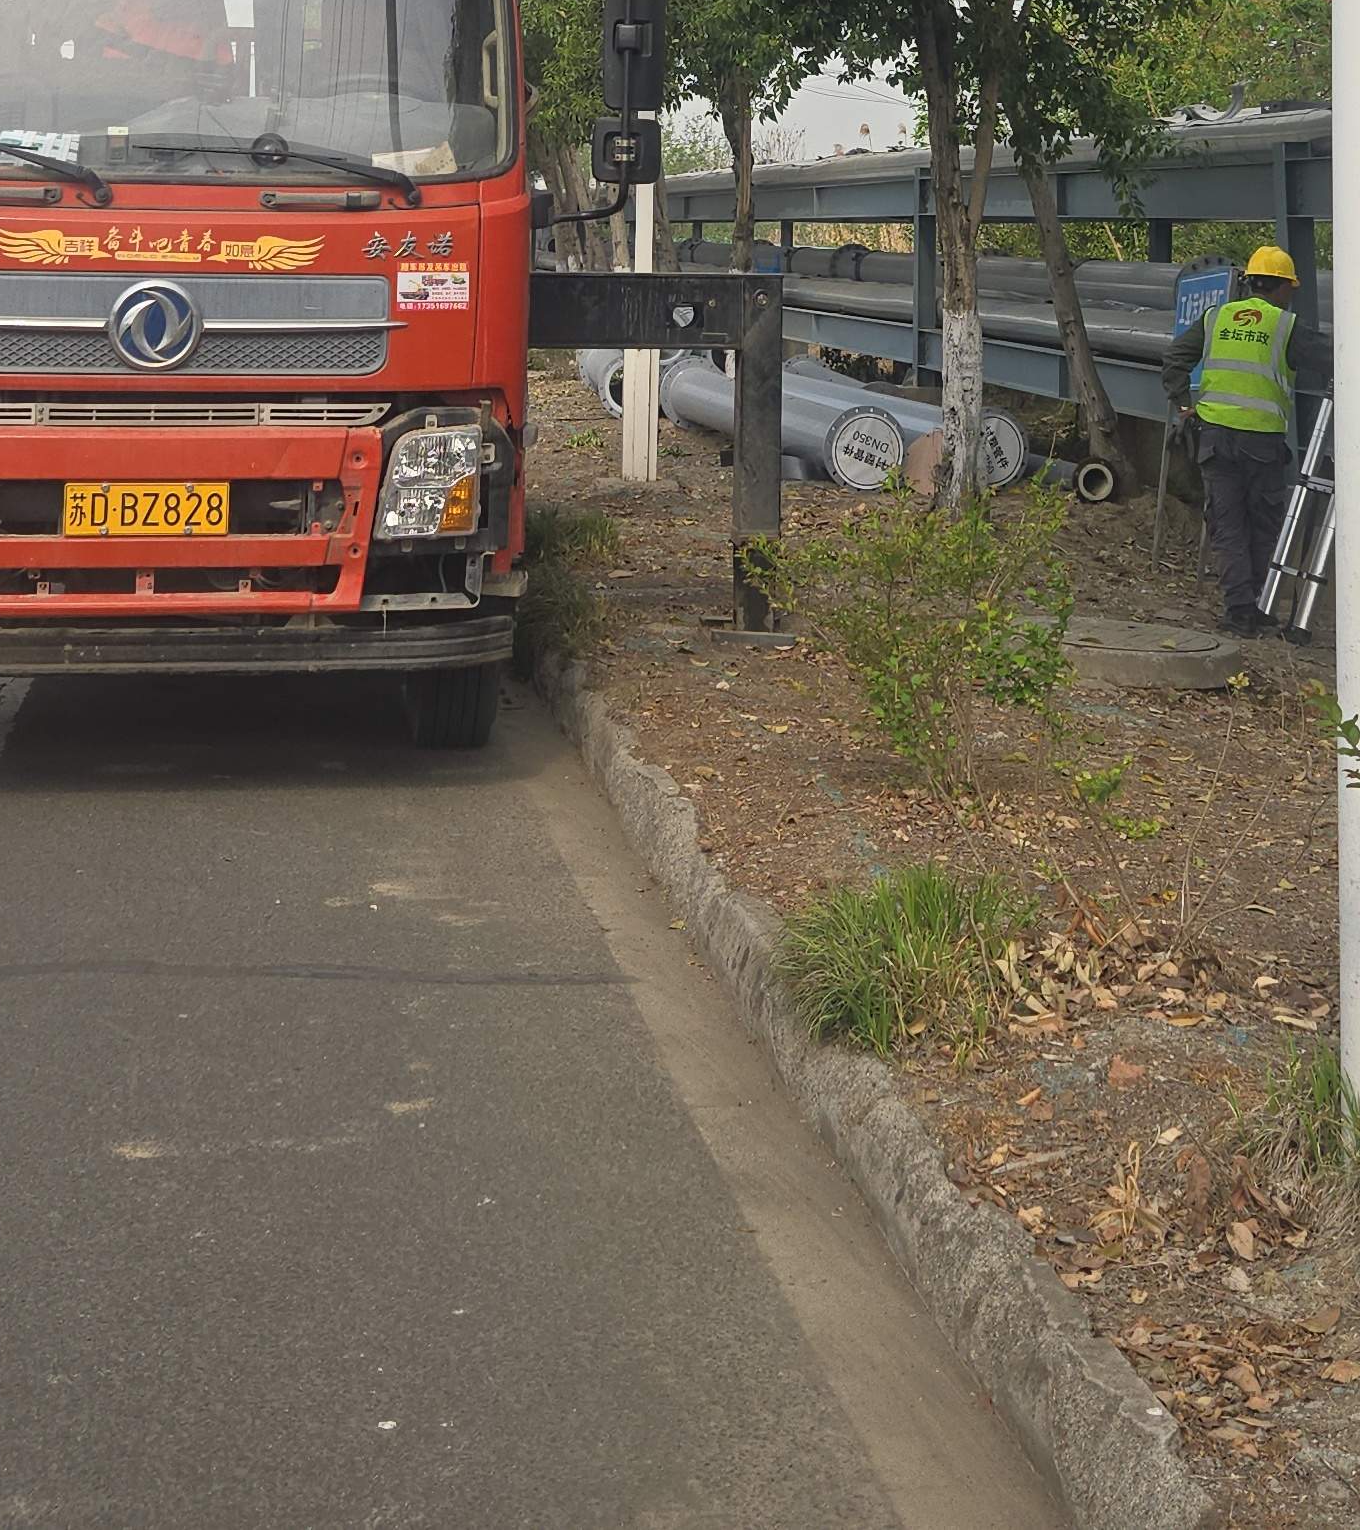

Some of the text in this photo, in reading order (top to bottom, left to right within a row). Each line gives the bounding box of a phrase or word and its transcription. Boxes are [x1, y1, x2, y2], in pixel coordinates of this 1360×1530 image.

[64, 239, 96, 253] 吉祥
[225, 243, 255, 258] 如意
[1219, 328, 1270, 346] 金坛市政
[852, 430, 889, 454] DN350
[69, 491, 224, 528] 苏D·BZ828
